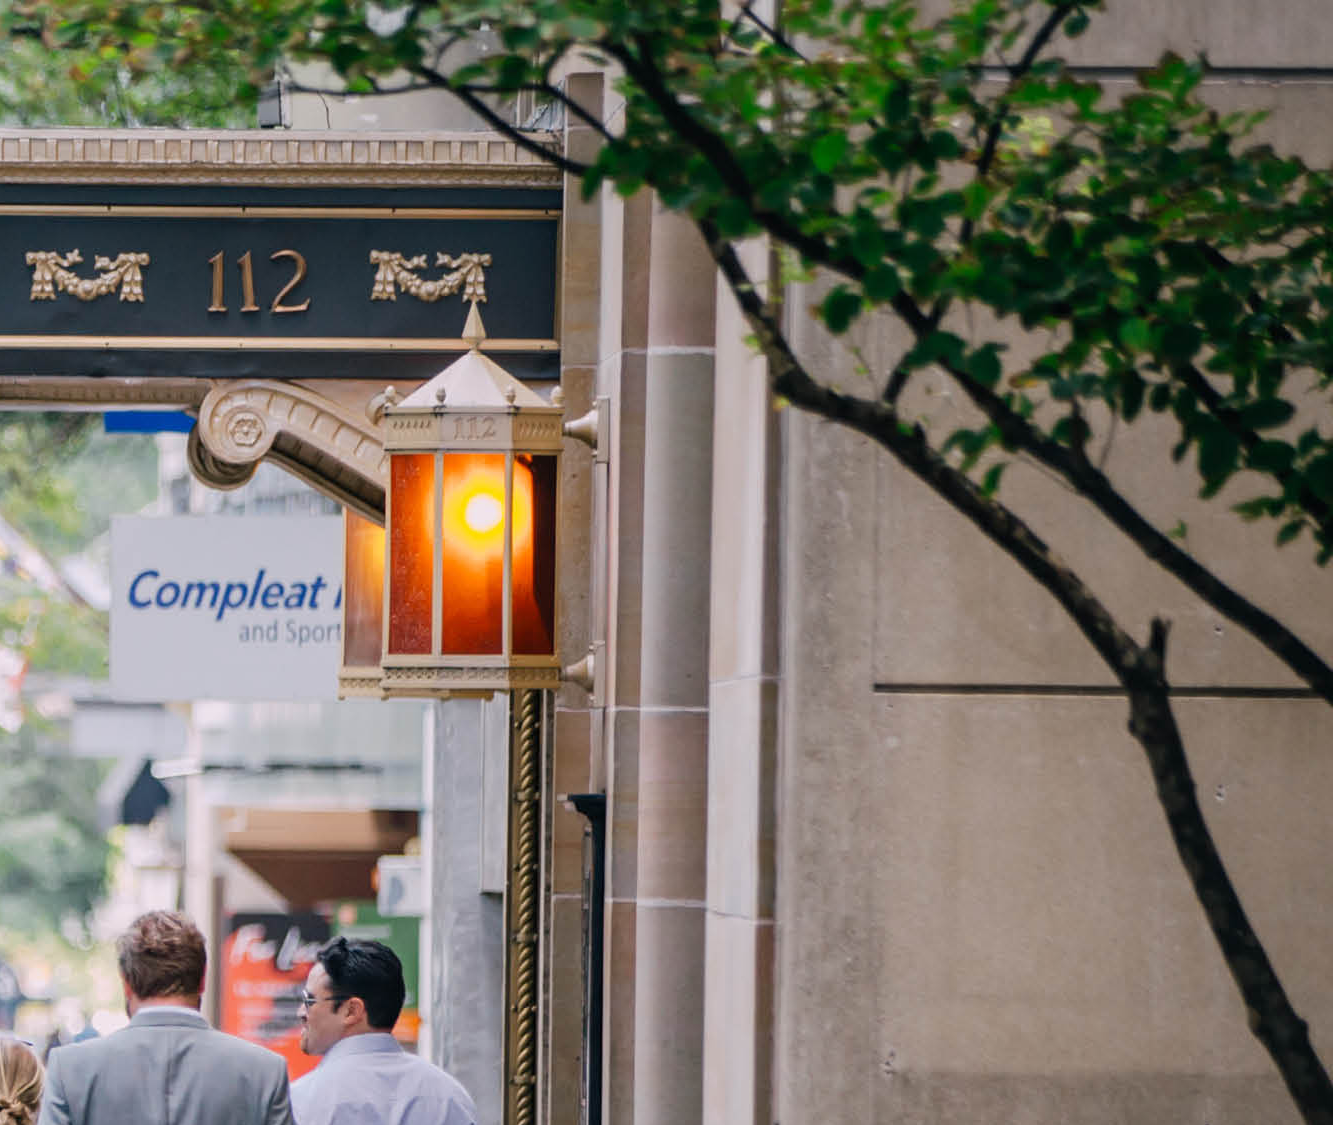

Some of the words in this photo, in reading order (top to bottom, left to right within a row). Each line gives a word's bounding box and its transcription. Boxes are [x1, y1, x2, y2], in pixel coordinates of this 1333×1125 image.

[207, 249, 311, 313] 112
[453, 416, 497, 441] 112
[127, 568, 328, 622] Compleat
[239, 619, 278, 643] and
